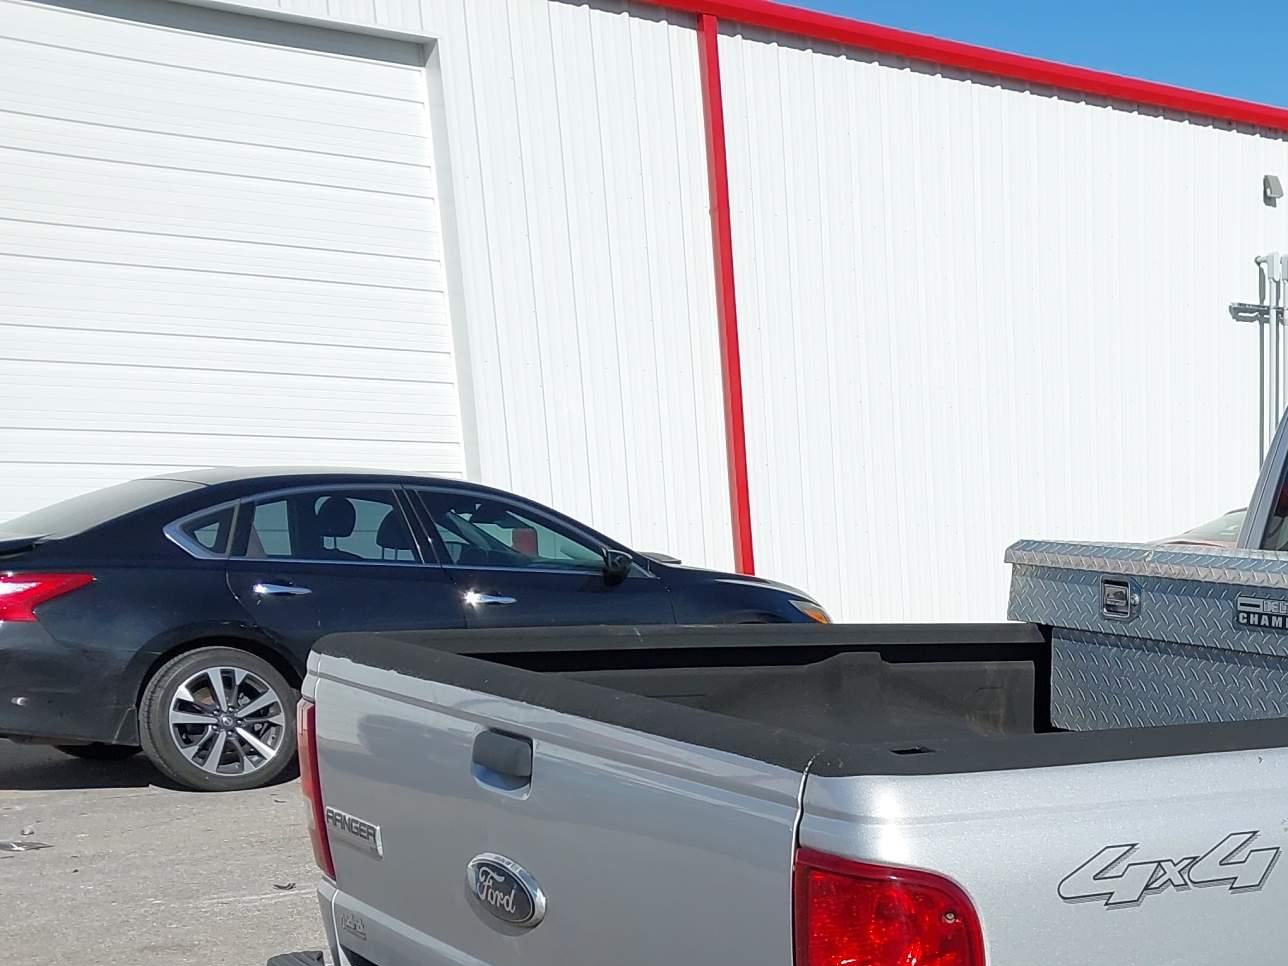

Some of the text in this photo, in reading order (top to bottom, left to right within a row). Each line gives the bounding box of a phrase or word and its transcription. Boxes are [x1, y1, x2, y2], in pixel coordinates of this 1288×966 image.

[326, 809, 376, 843] RANGER
[477, 867, 516, 914] Ford
[1057, 830, 1282, 910] 4x4
